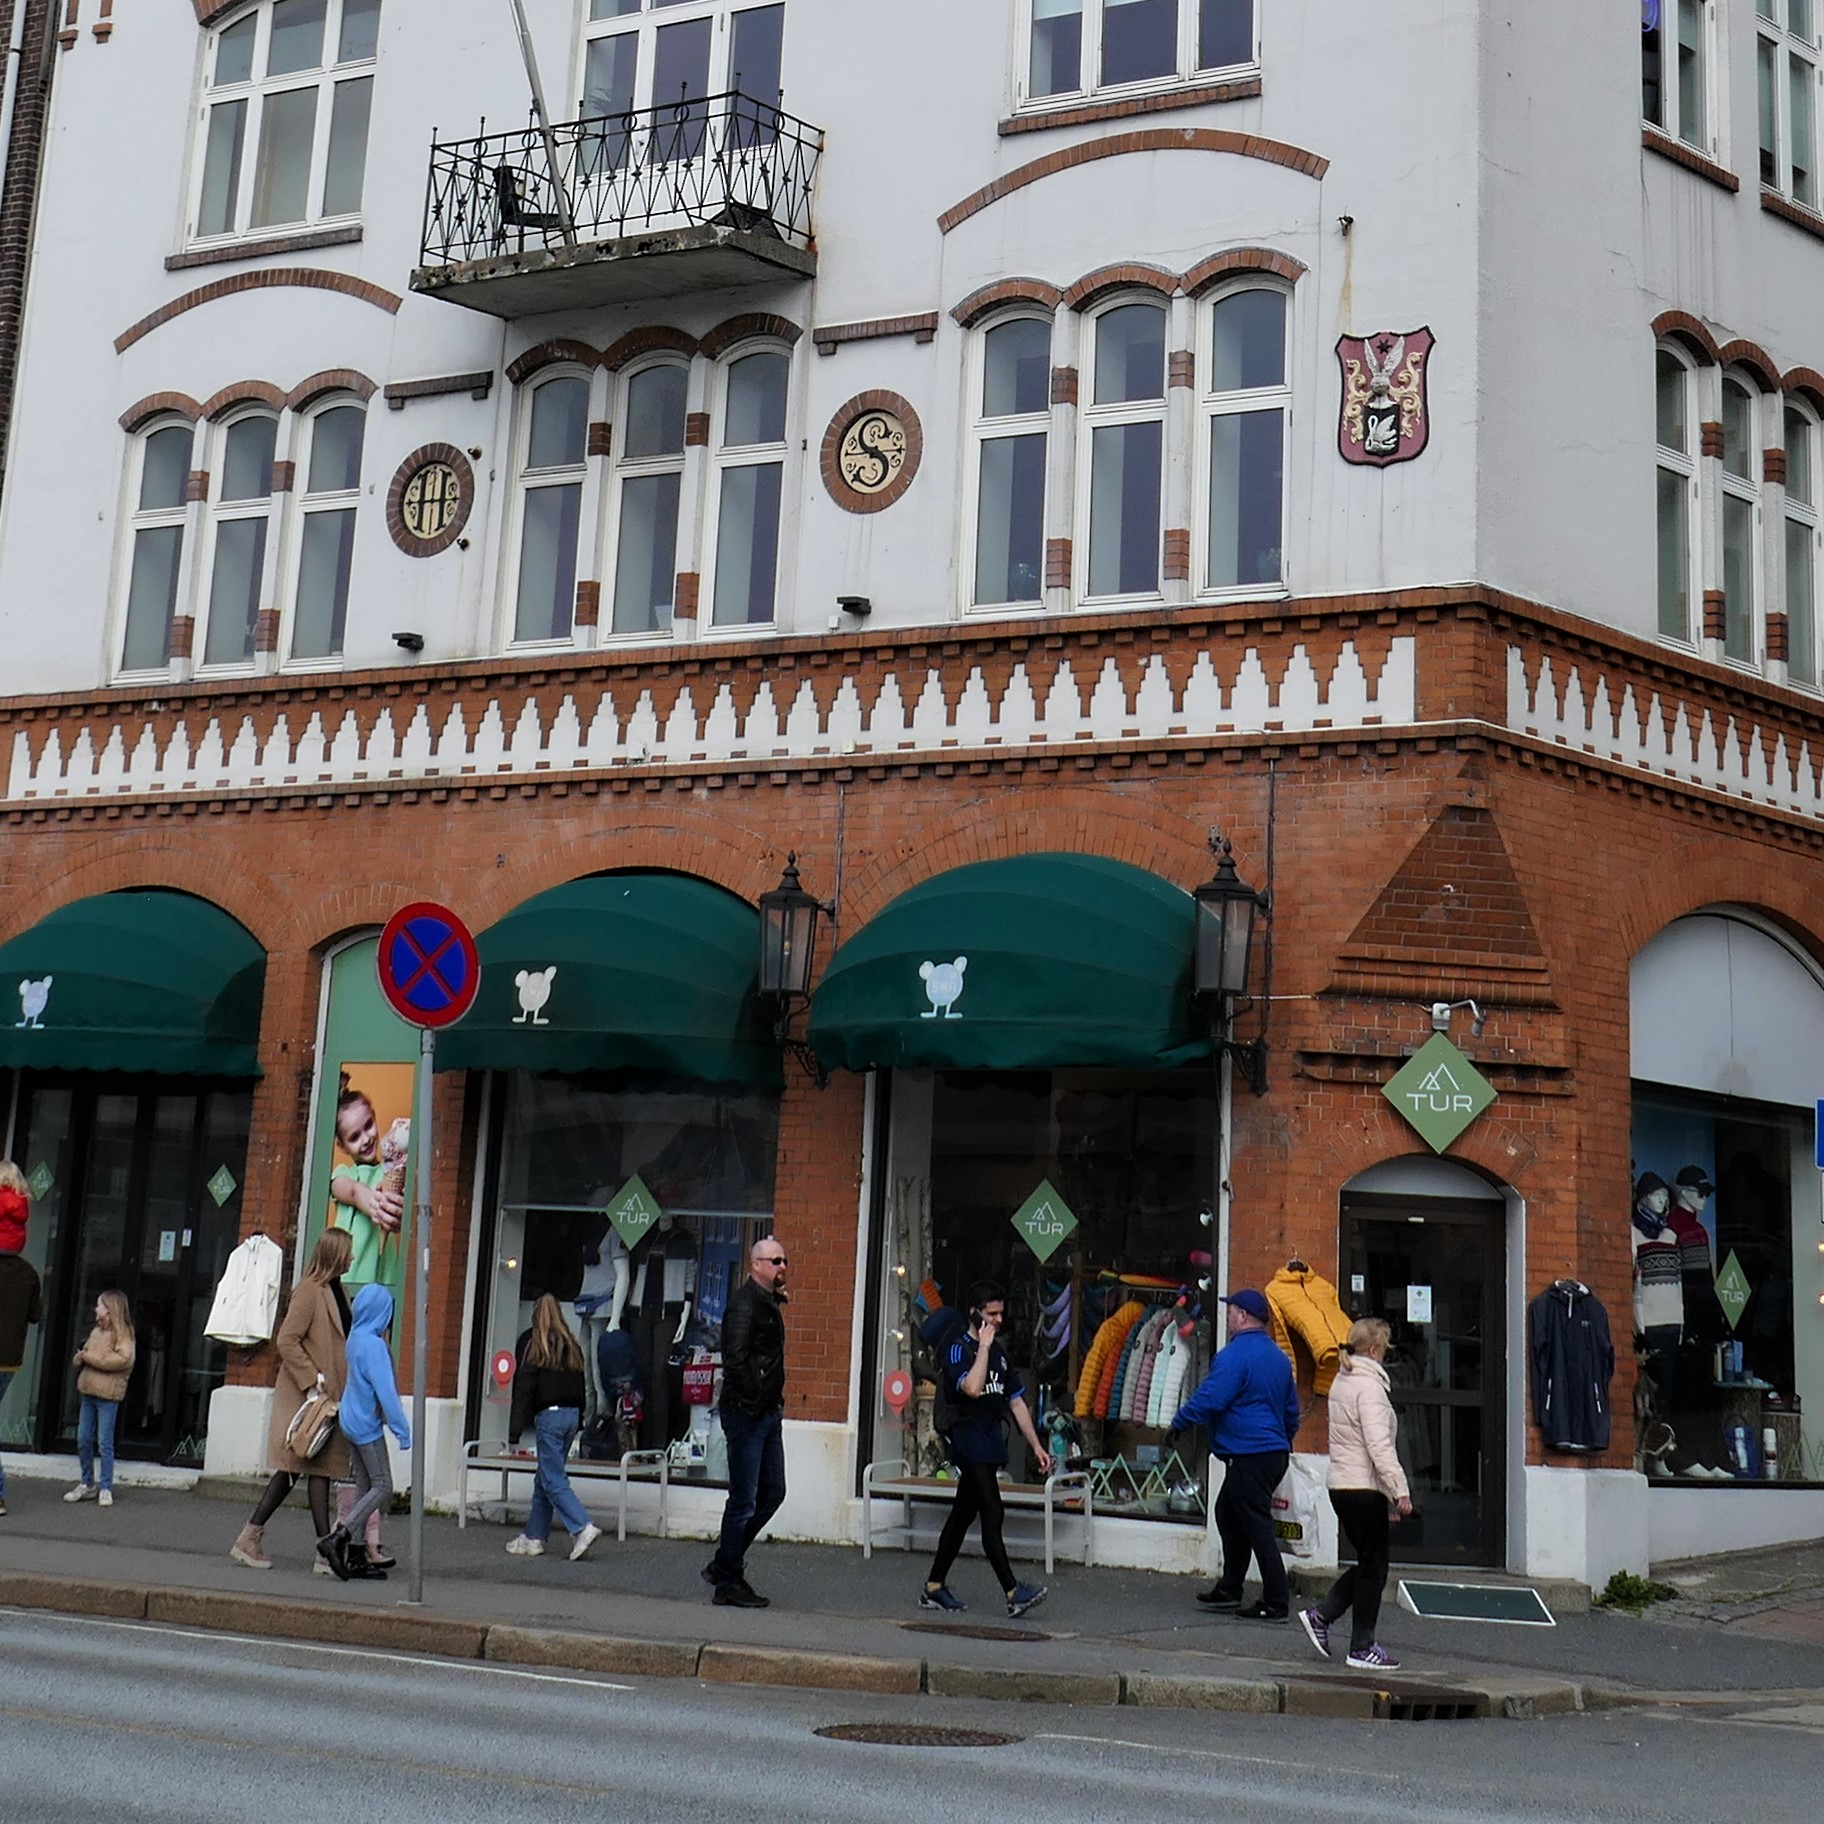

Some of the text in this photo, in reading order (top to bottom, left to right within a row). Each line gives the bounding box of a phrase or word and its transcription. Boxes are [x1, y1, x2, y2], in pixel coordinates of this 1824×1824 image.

[1405, 1093, 1473, 1113] TUR
[213, 1184, 231, 1194] TUR
[616, 1211, 650, 1225] TUR
[1025, 1221, 1064, 1235] TUR
[1721, 1289, 1744, 1303] TUR
